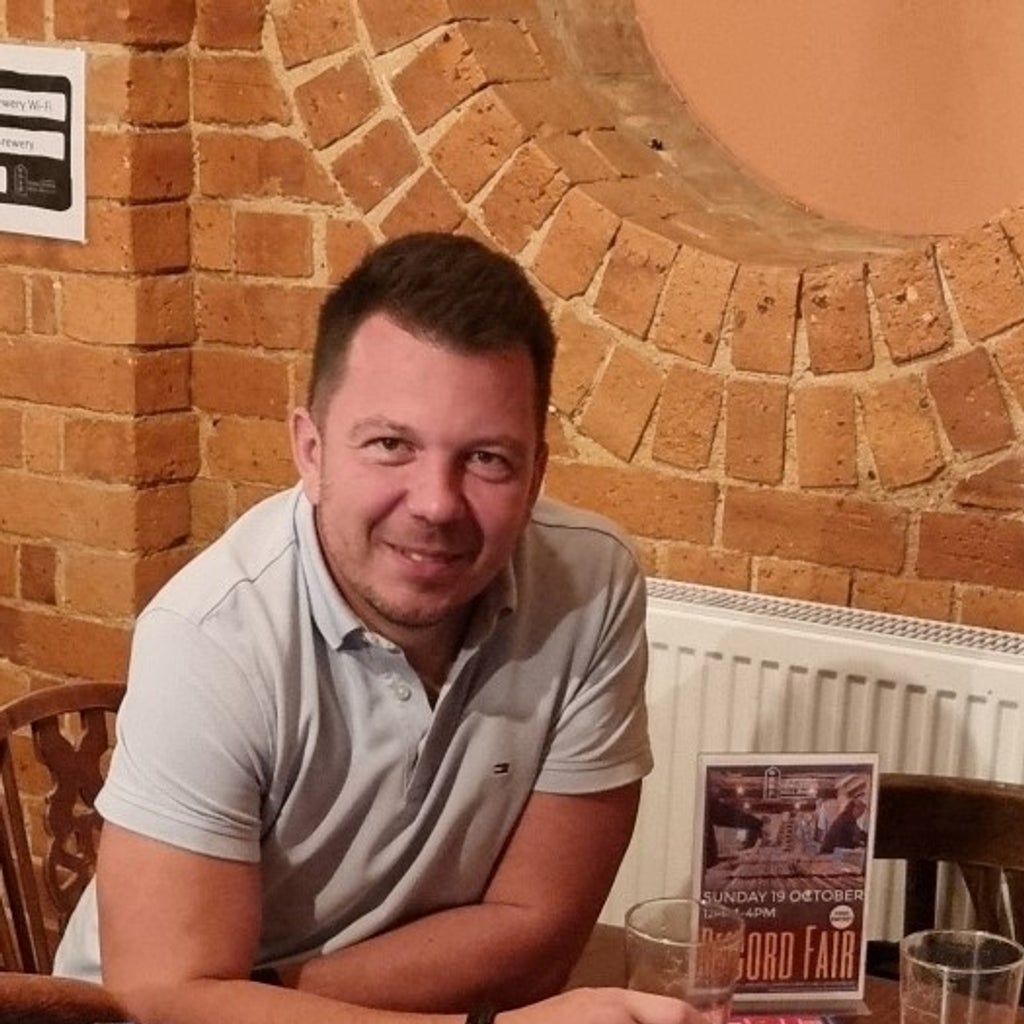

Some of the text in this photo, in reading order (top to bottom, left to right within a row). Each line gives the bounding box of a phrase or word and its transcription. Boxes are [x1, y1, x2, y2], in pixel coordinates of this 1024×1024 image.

[0, 99, 26, 111] wery
[0, 138, 34, 151] rewery
[703, 889, 864, 902] SUNDAY 19 OCTOBER
